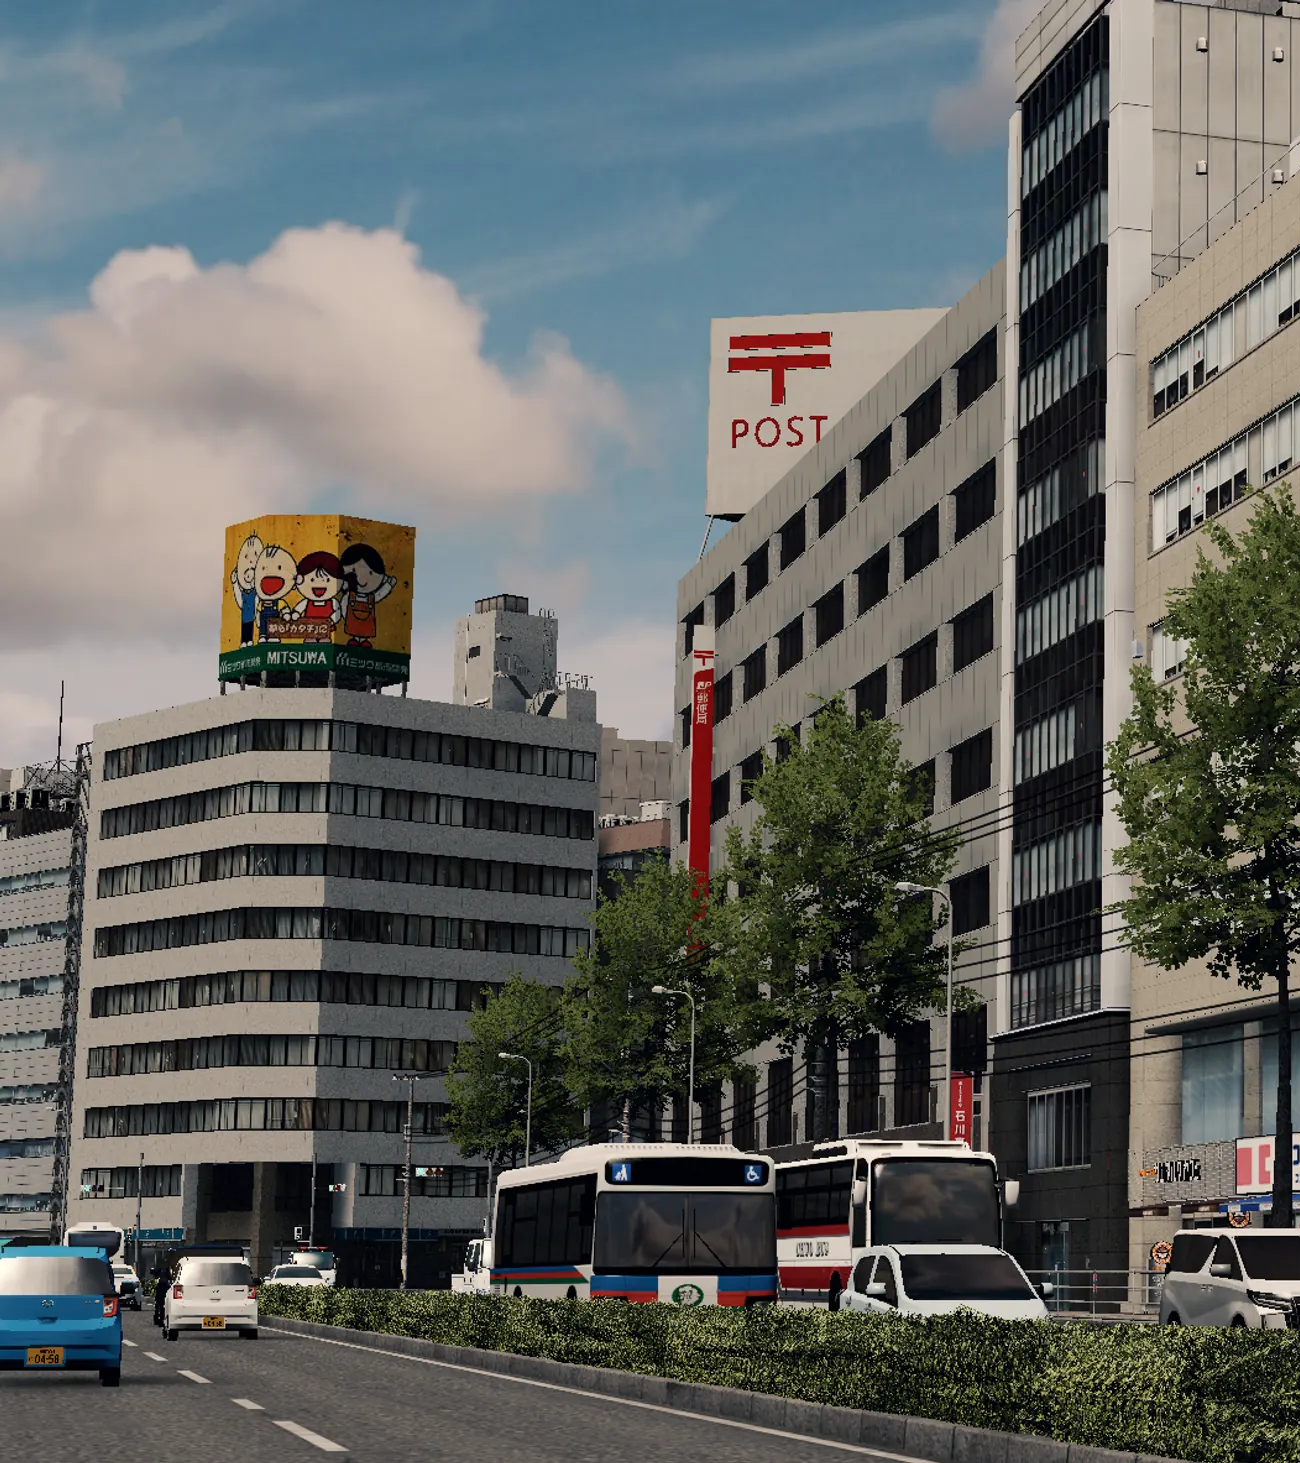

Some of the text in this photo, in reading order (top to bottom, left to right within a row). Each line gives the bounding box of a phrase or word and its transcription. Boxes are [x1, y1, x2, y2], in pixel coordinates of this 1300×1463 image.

[731, 415, 829, 448] POST
[266, 651, 327, 665] MITSUWA
[955, 1110, 966, 1141] 石川
[34, 1354, 59, 1364] 04-58
